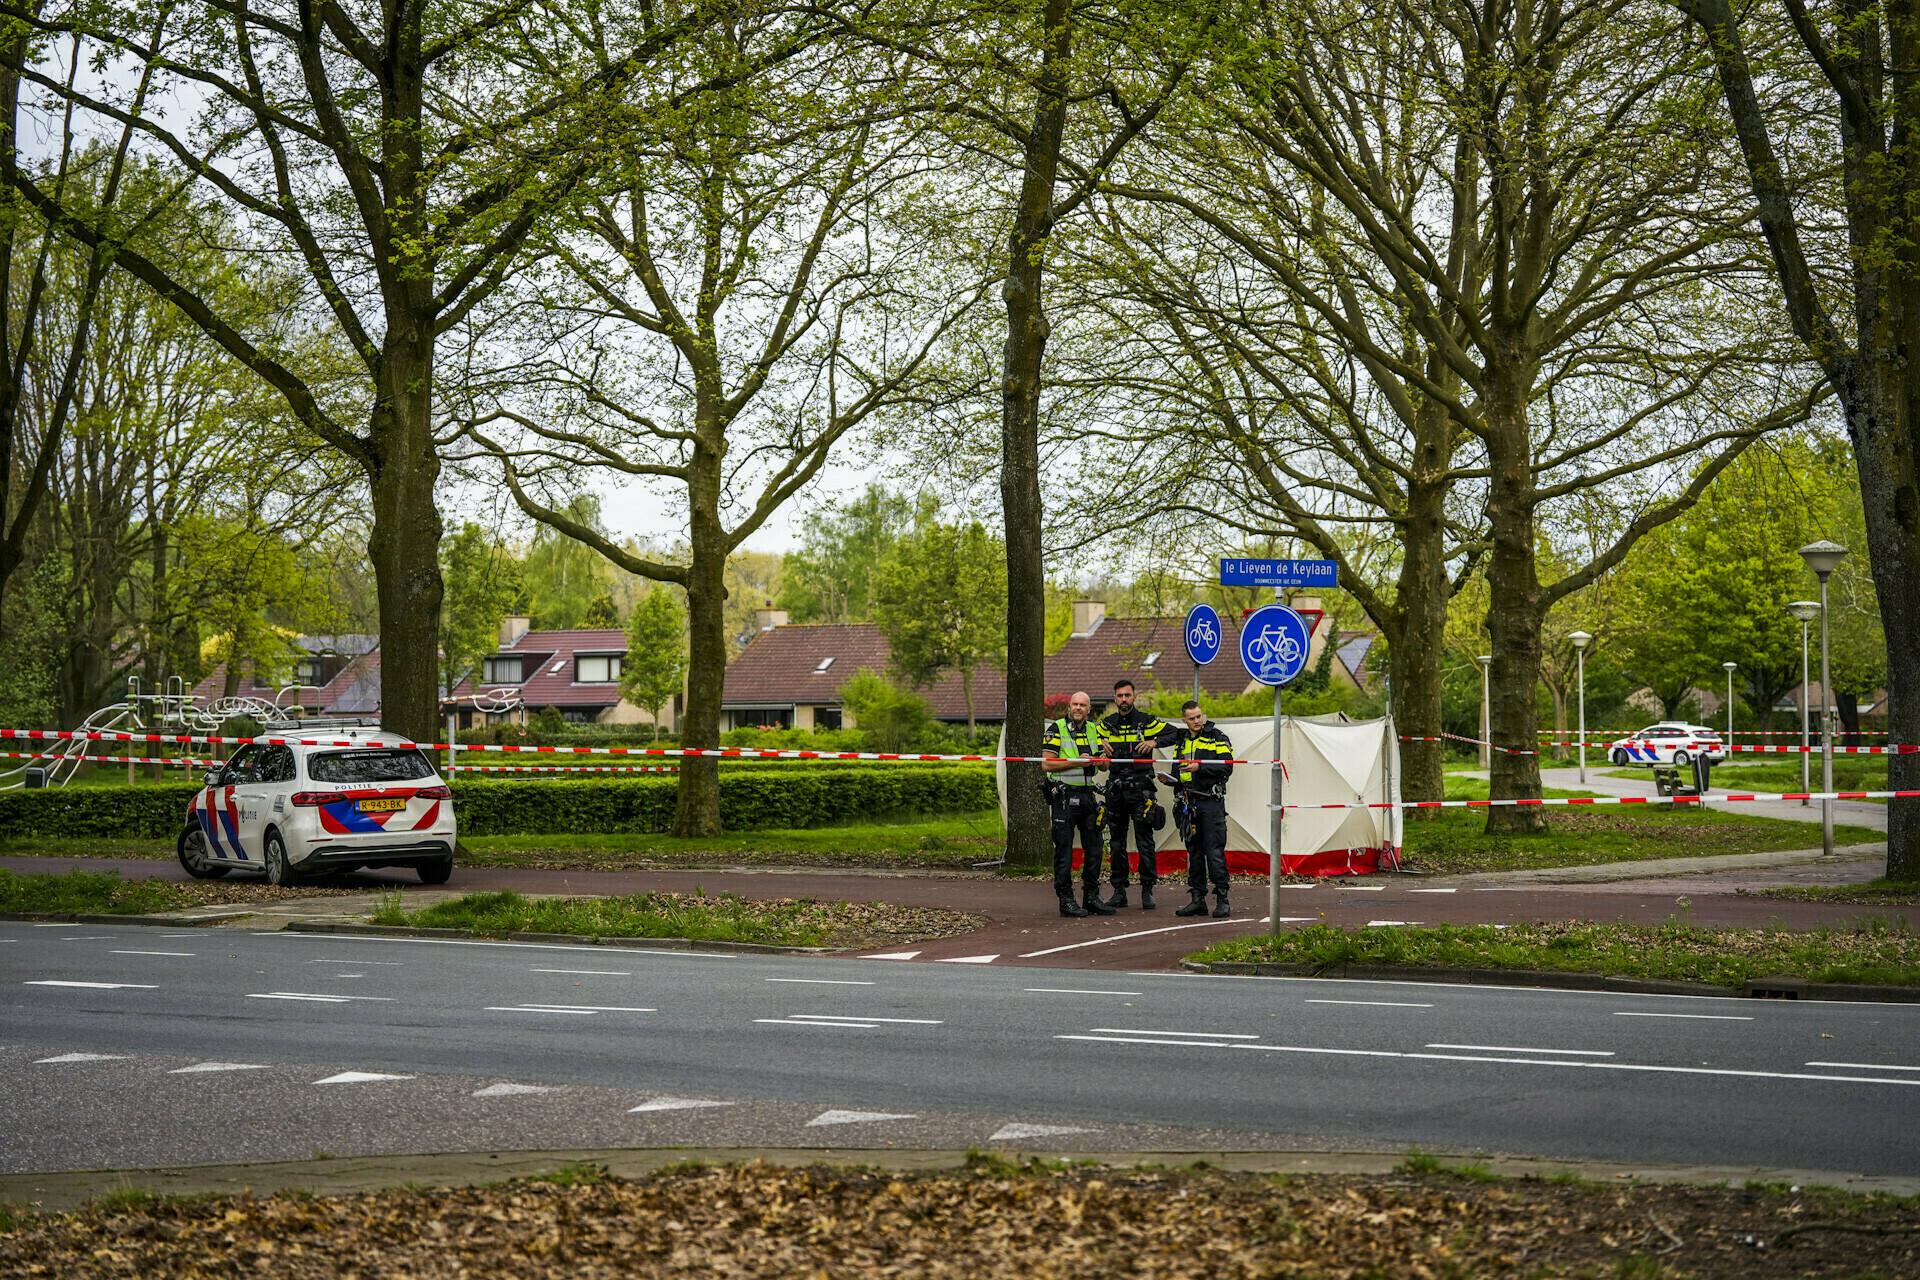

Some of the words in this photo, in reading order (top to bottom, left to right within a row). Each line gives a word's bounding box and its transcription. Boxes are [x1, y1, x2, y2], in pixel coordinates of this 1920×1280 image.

[1239, 561, 1272, 574] Lieven
[1276, 562, 1288, 575] de
[1292, 562, 1332, 578] Keylaan
[335, 783, 372, 791] POLITIE
[361, 800, 402, 810] R-943-BK
